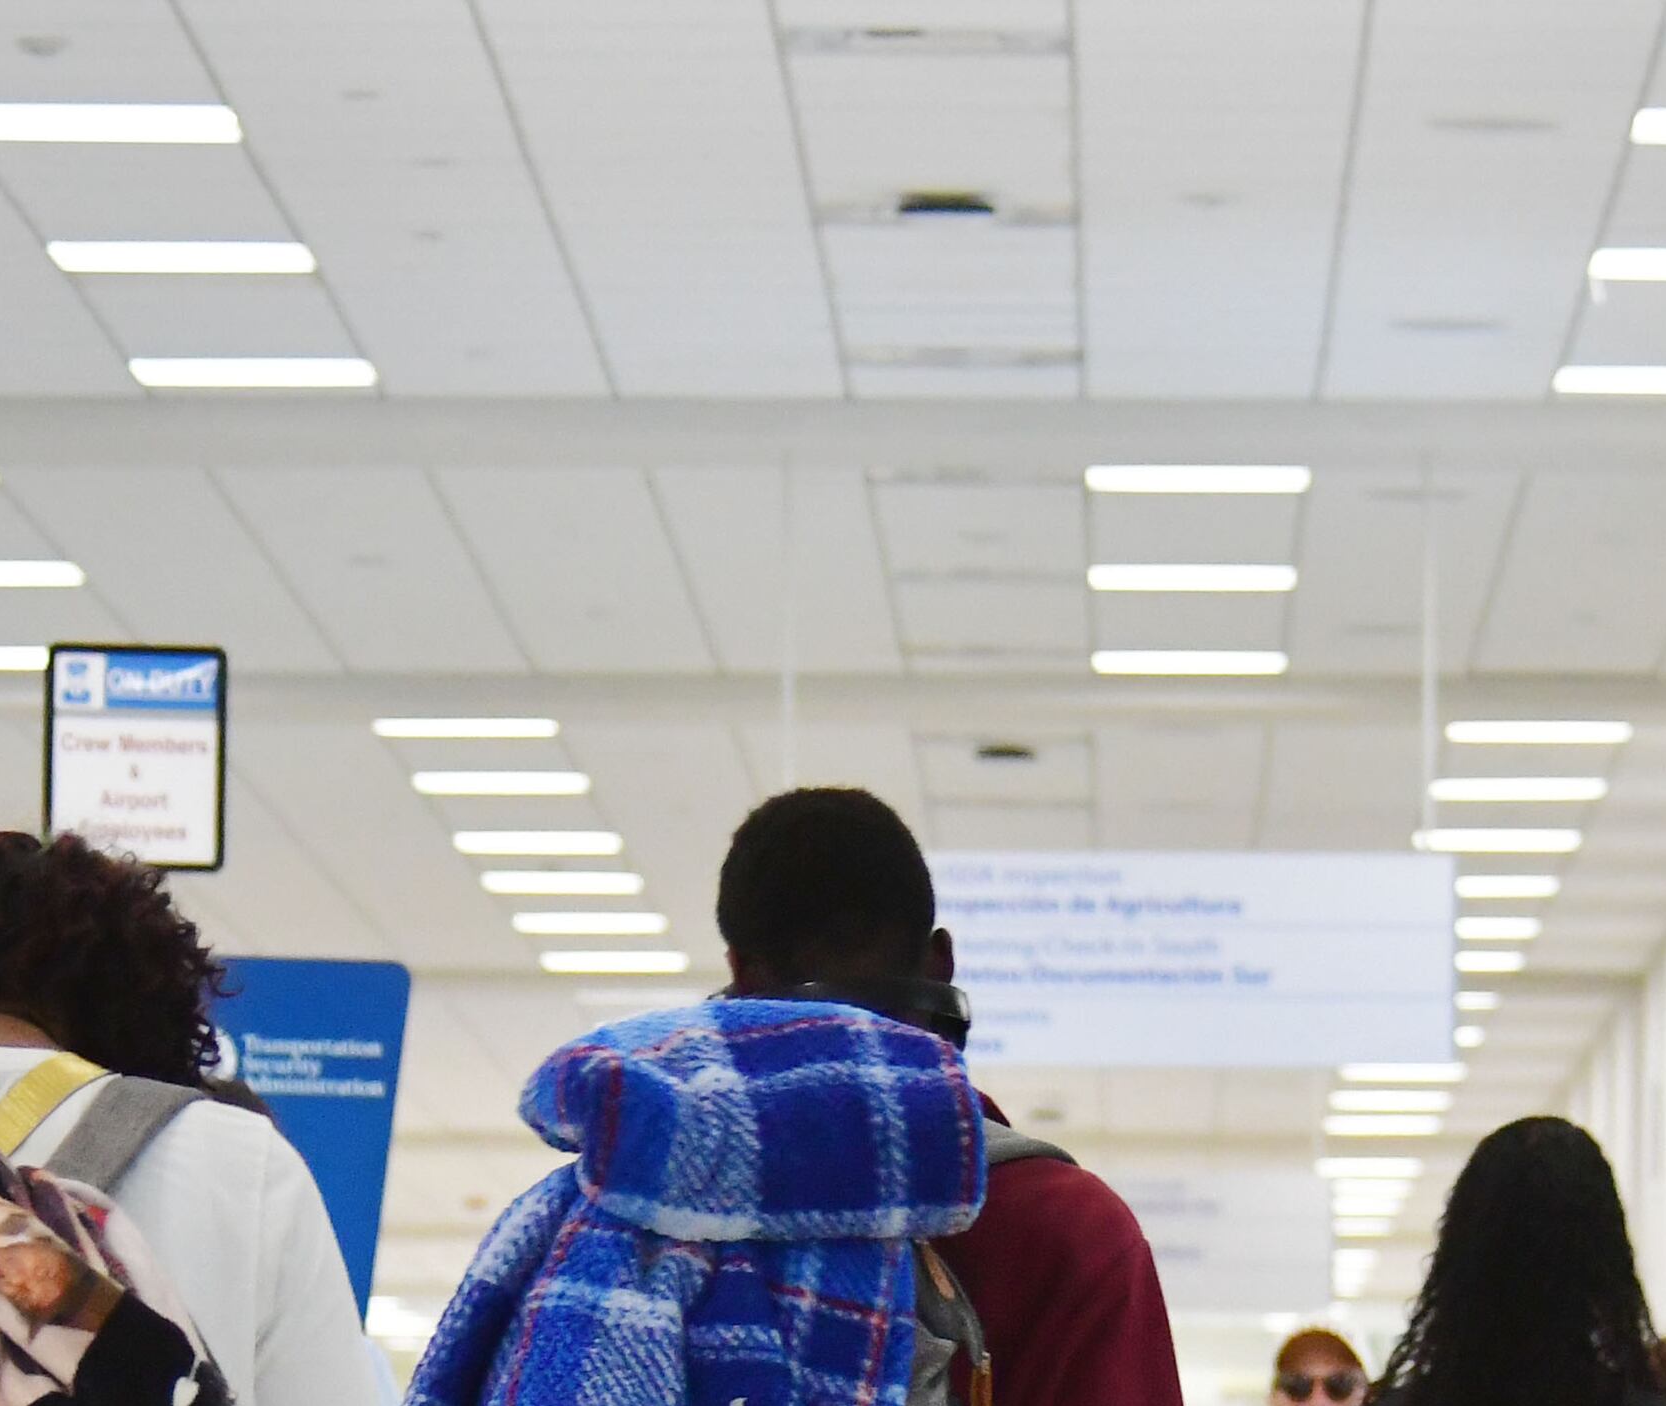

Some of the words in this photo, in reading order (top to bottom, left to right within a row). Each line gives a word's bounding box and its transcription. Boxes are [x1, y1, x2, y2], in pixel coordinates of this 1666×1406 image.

[61, 732, 111, 752] Crew
[118, 732, 209, 754] Members
[100, 789, 169, 810] Airport
[242, 1032, 384, 1060] Transportation
[242, 1056, 323, 1079] Security
